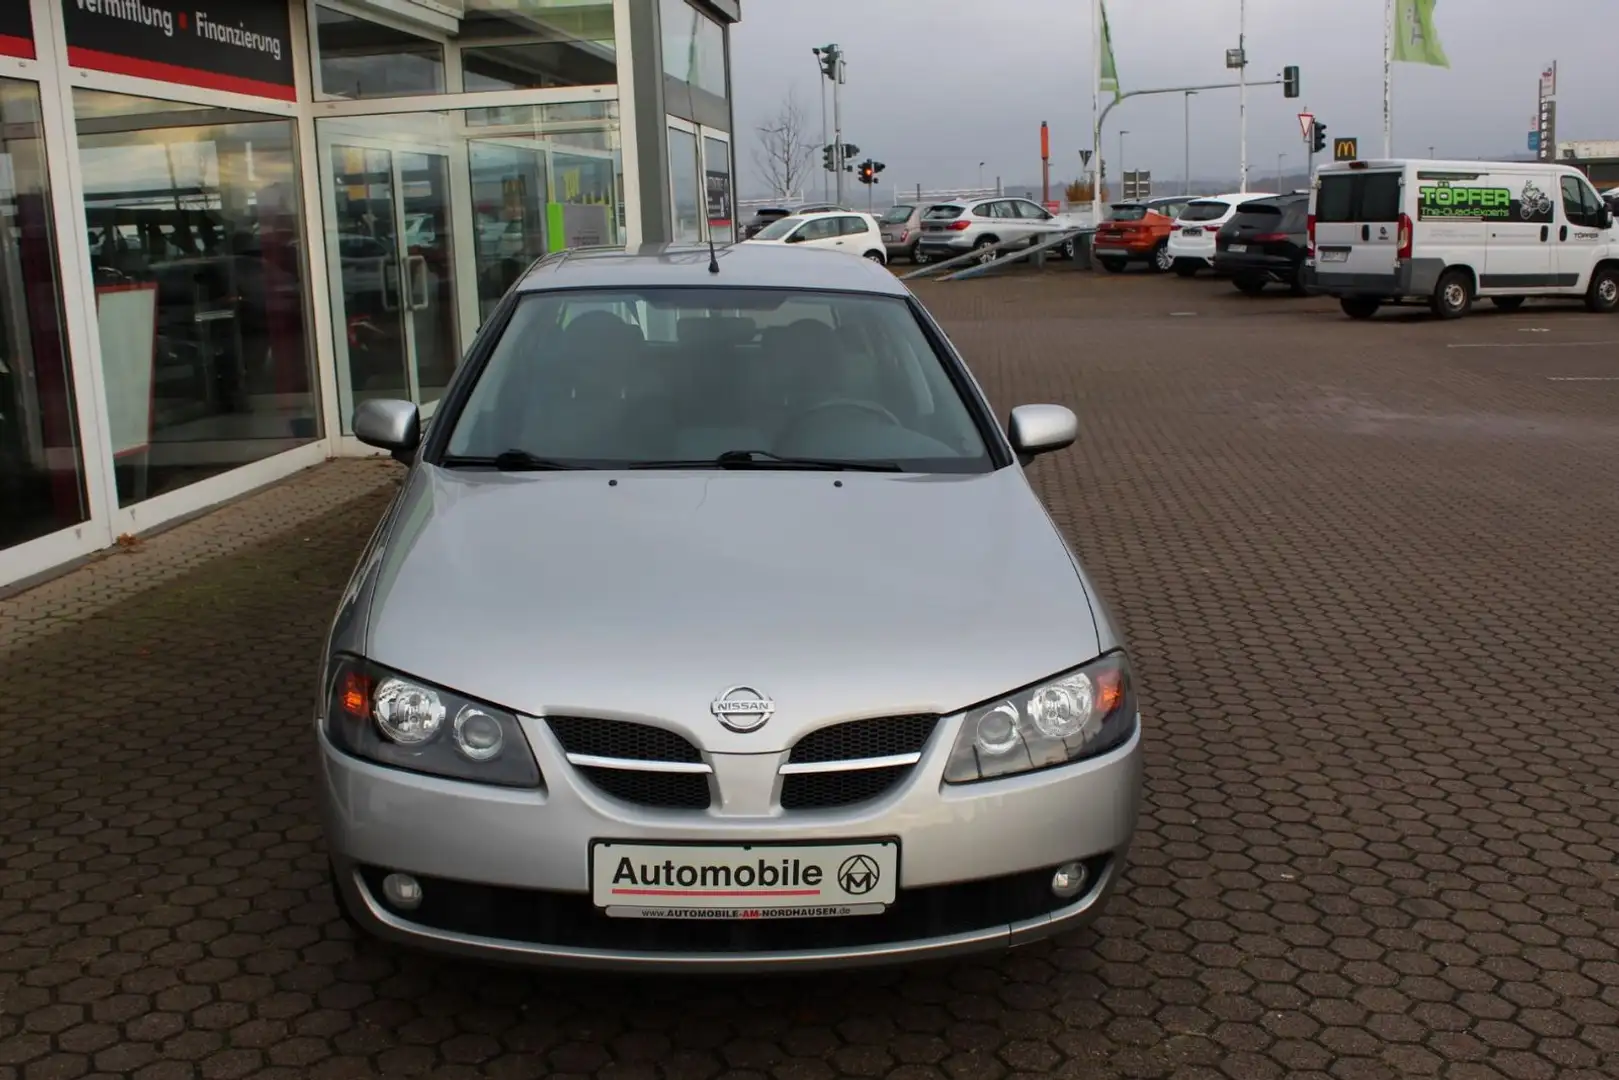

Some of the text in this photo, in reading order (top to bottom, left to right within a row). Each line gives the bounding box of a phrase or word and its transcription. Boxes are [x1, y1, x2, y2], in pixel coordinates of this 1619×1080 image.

[195, 12, 282, 61] Finanzierung
[1419, 181, 1511, 206] TÖPFER
[717, 702, 769, 711] NISSAN
[612, 857, 823, 888] Automobile
[641, 906, 851, 918] www.AUTOMOBILE-AM-NORDHAUSEN.de
